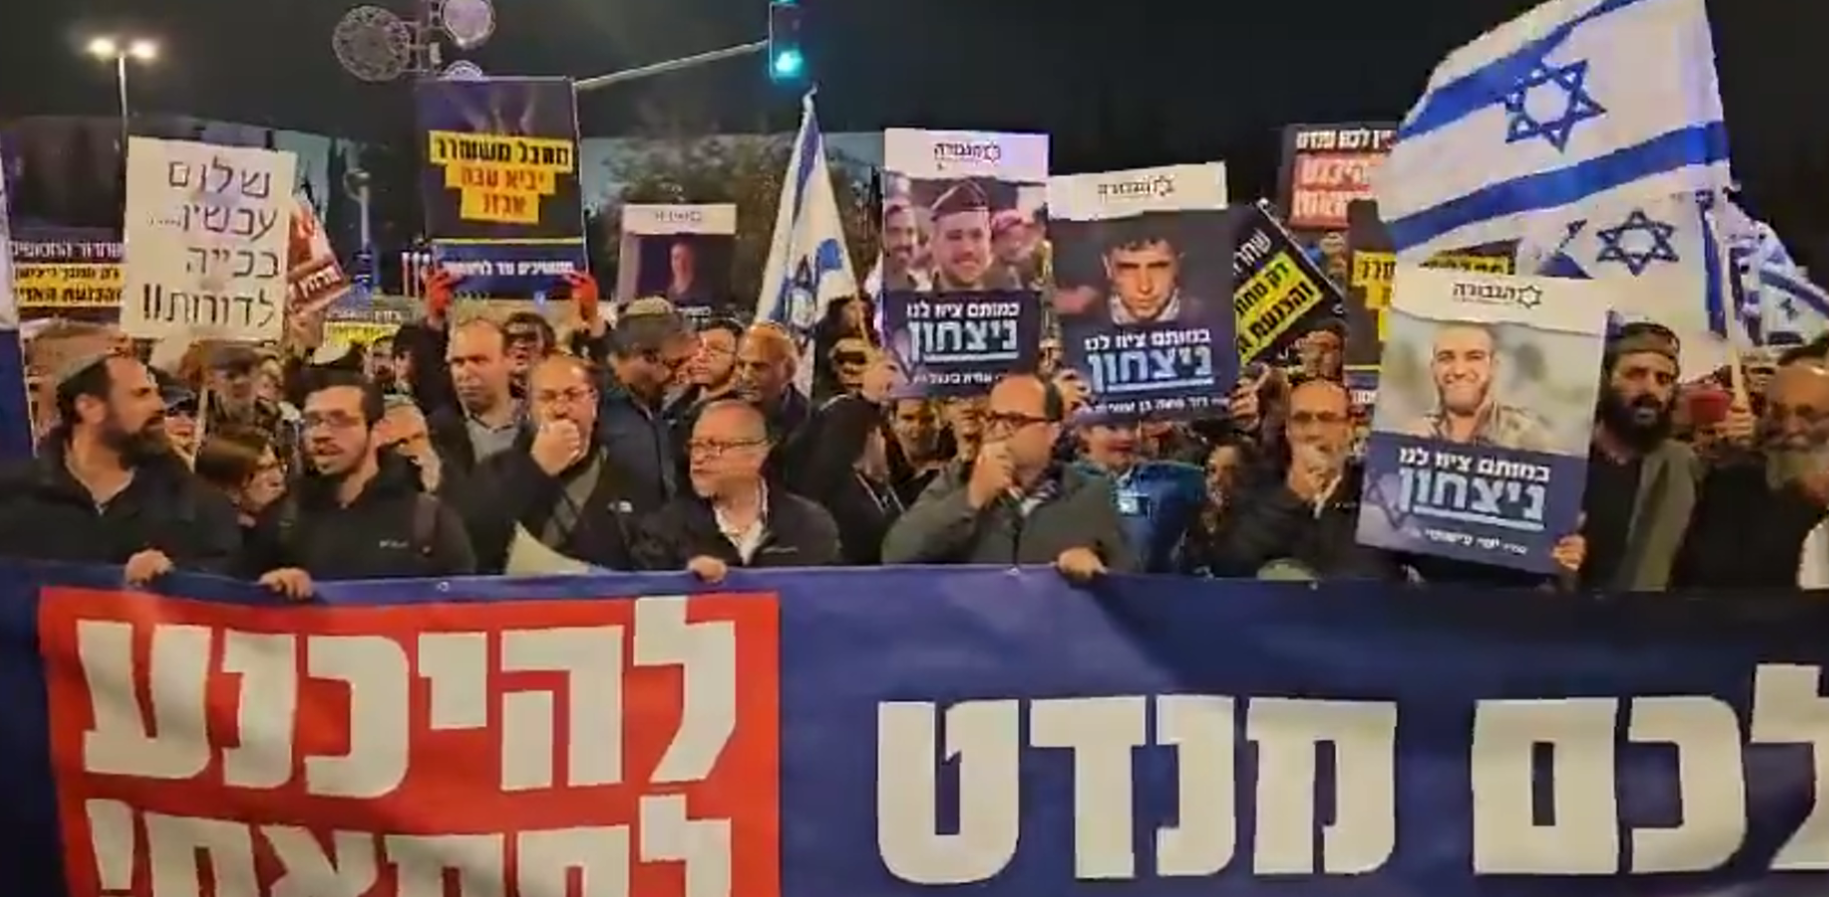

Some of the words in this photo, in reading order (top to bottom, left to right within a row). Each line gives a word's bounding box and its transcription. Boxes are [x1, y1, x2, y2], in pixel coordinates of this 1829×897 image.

[169, 155, 271, 199] שלום
[186, 246, 279, 279] בכייה
[1452, 283, 1516, 300] הגבורה
[907, 319, 1018, 362] ניצחון
[1087, 346, 1213, 393] ניצחון
[1478, 456, 1551, 483] במותם
[1399, 467, 1547, 521] ניצחון
[76, 595, 737, 799] להיכנע
[877, 694, 1398, 885] מנדט
[1471, 663, 1829, 876] לכם
